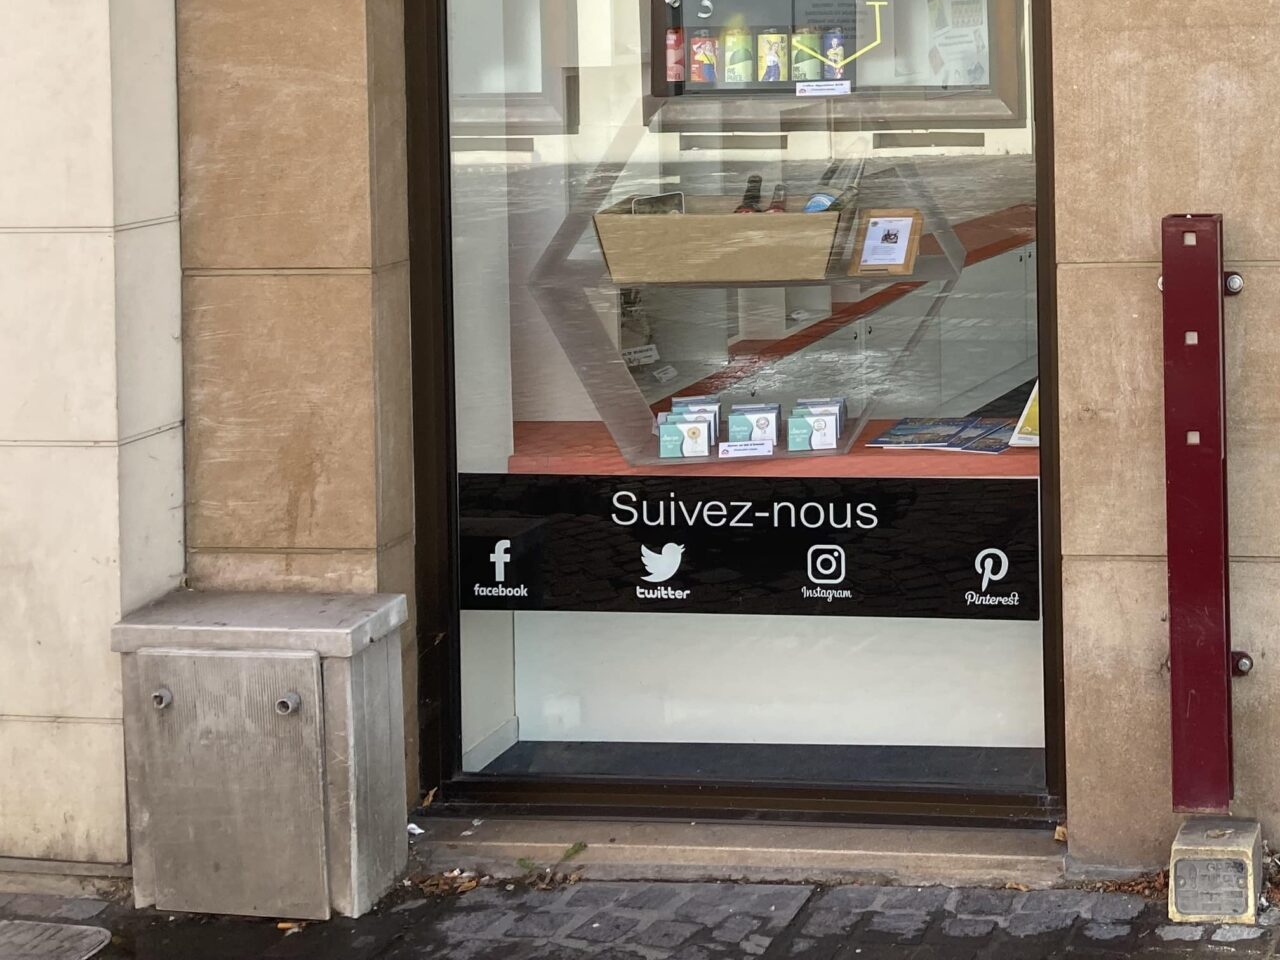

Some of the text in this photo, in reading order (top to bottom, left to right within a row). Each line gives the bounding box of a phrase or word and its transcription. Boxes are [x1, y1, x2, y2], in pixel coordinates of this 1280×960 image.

[610, 490, 879, 530] Suivez-nous
[473, 583, 528, 598] facebook
[636, 585, 690, 600] twitter
[801, 585, 853, 603] Instagram
[965, 590, 1020, 607] Pinterest
